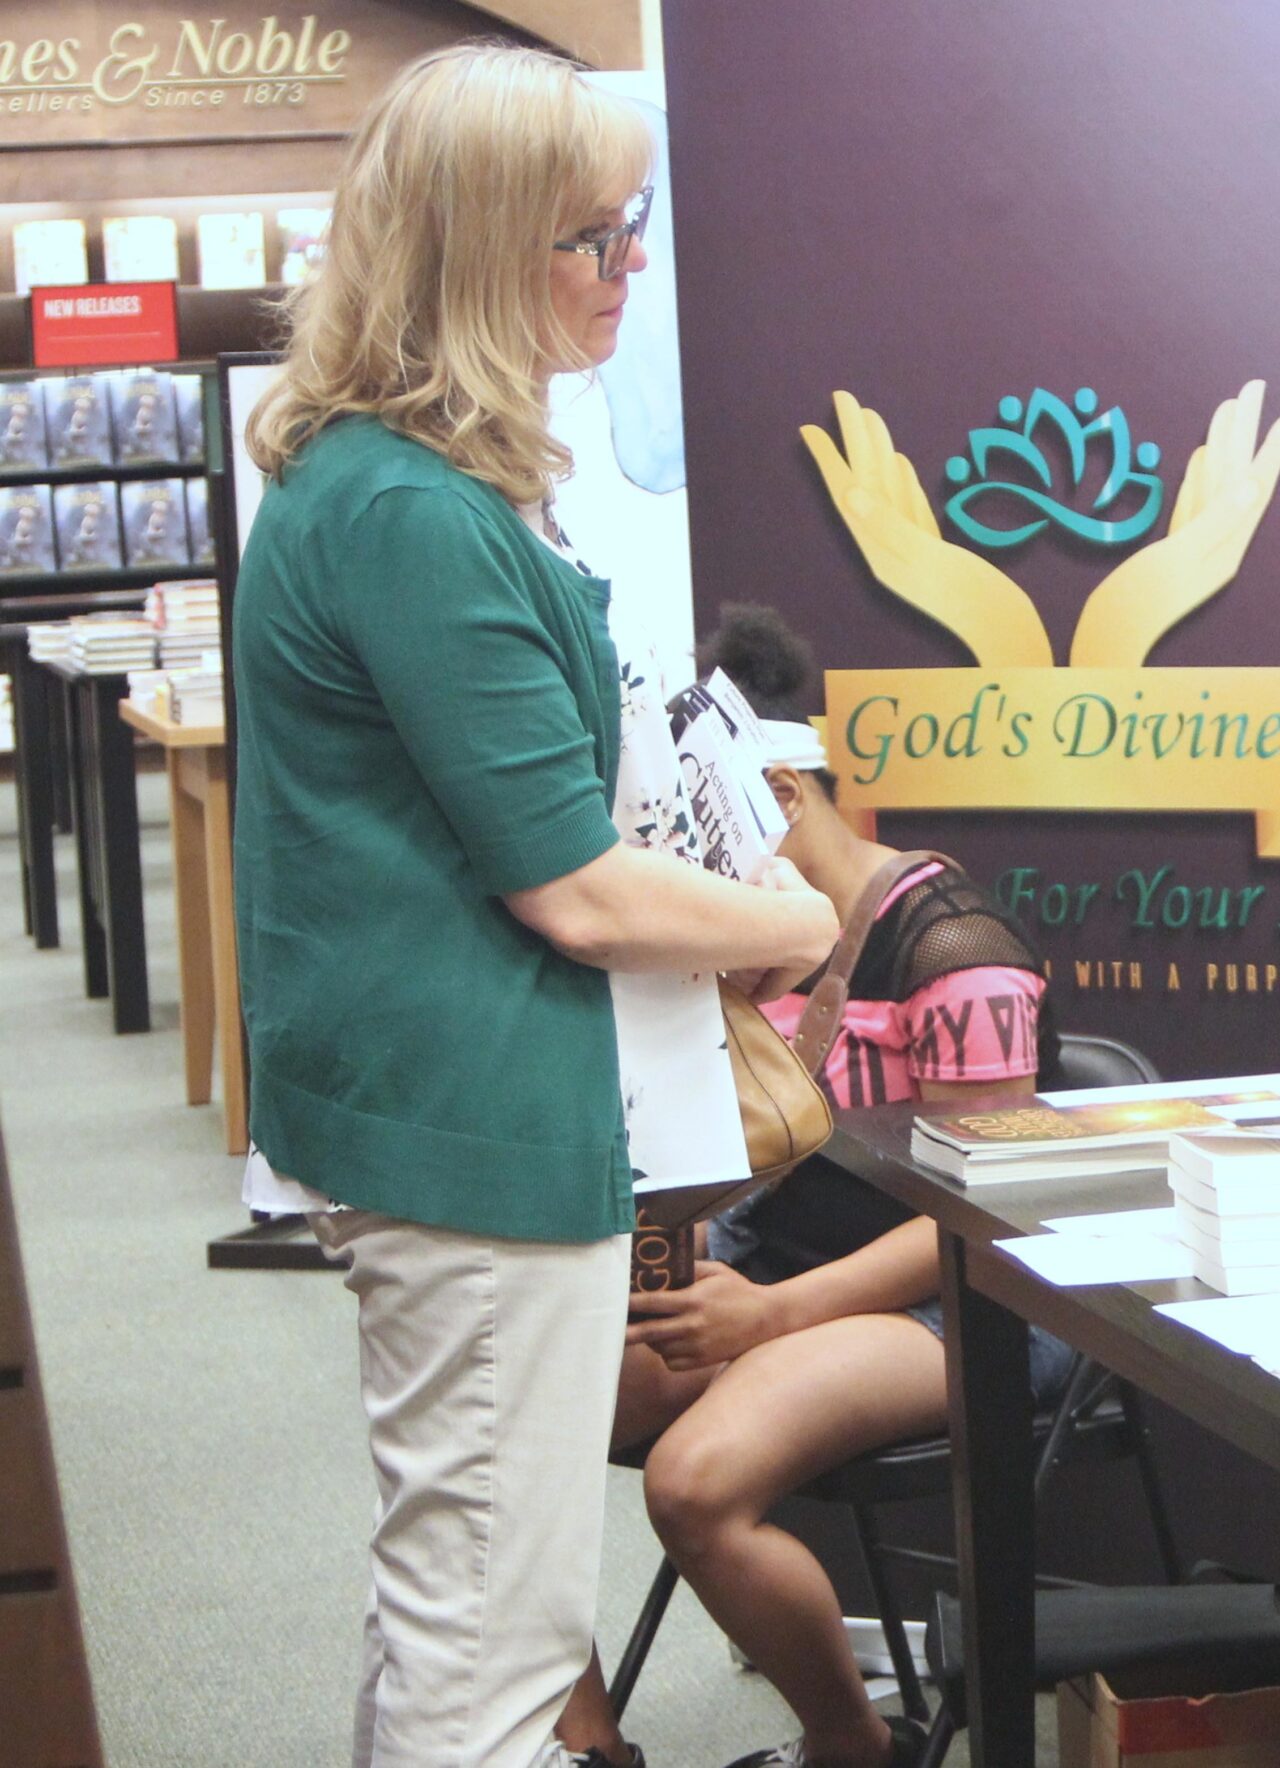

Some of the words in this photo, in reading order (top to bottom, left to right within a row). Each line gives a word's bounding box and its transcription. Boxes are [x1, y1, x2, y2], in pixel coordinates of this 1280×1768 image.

[93, 23, 157, 102] &
[167, 15, 349, 77] Noble
[0, 92, 94, 113] ellers
[145, 86, 225, 108] Since
[243, 82, 305, 104] 1873
[44, 299, 73, 319] NEW
[76, 296, 141, 317] RELEASES
[845, 683, 1033, 785] God's
[705, 760, 735, 823] Acting
[731, 818, 744, 846] on
[995, 867, 1100, 925] For
[1116, 864, 1266, 928] Your
[1075, 960, 1143, 989] WITH
[1167, 962, 1181, 991] A
